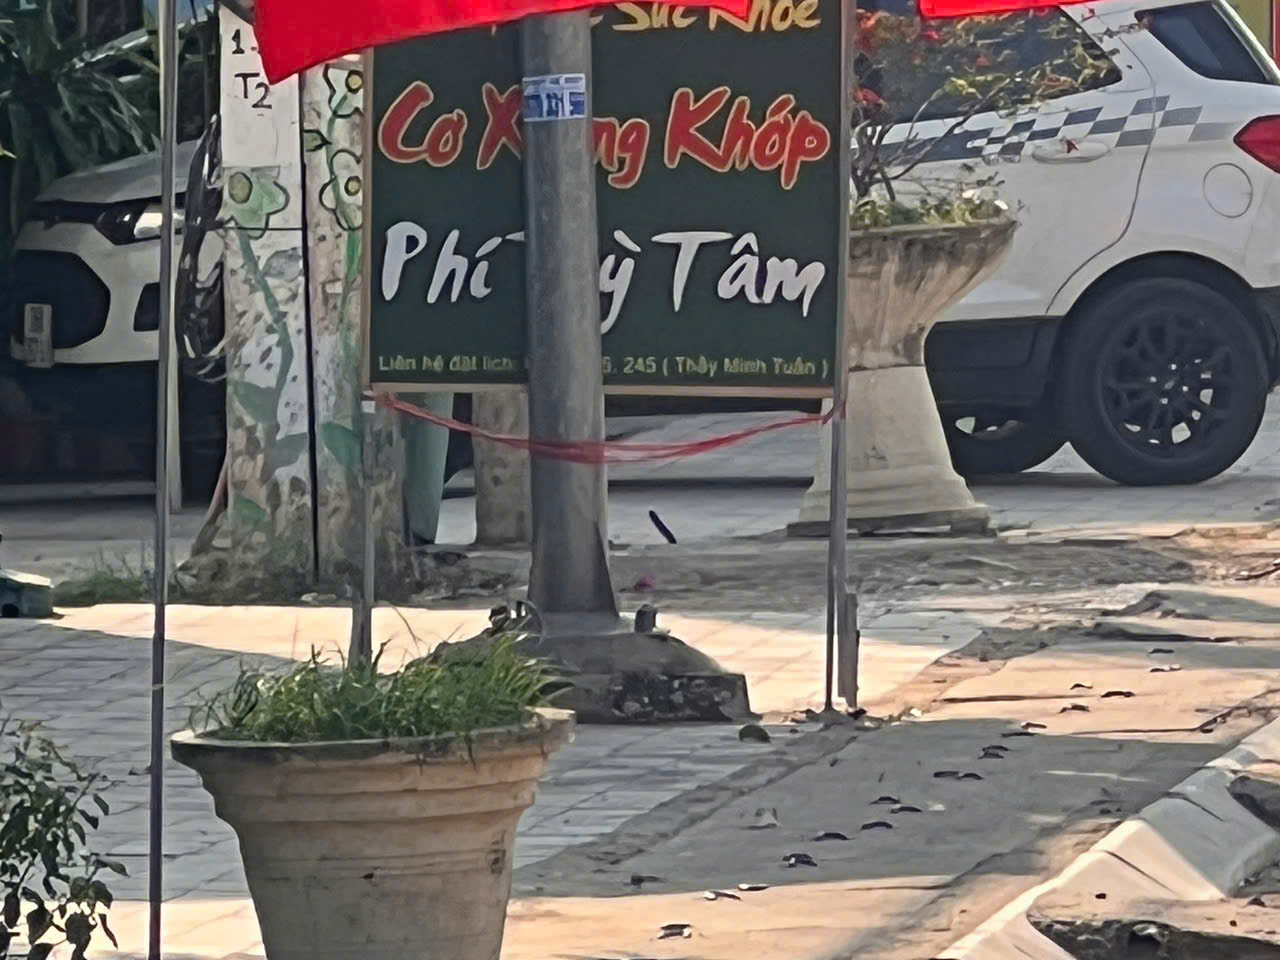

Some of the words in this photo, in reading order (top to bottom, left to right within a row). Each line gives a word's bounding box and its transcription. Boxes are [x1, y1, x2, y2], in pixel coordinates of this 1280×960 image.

[378, 81, 467, 167] Cơ
[476, 82, 650, 189] Xng
[664, 86, 831, 190] Khớp
[381, 222, 502, 303] Phí
[651, 231, 826, 318] Tâm
